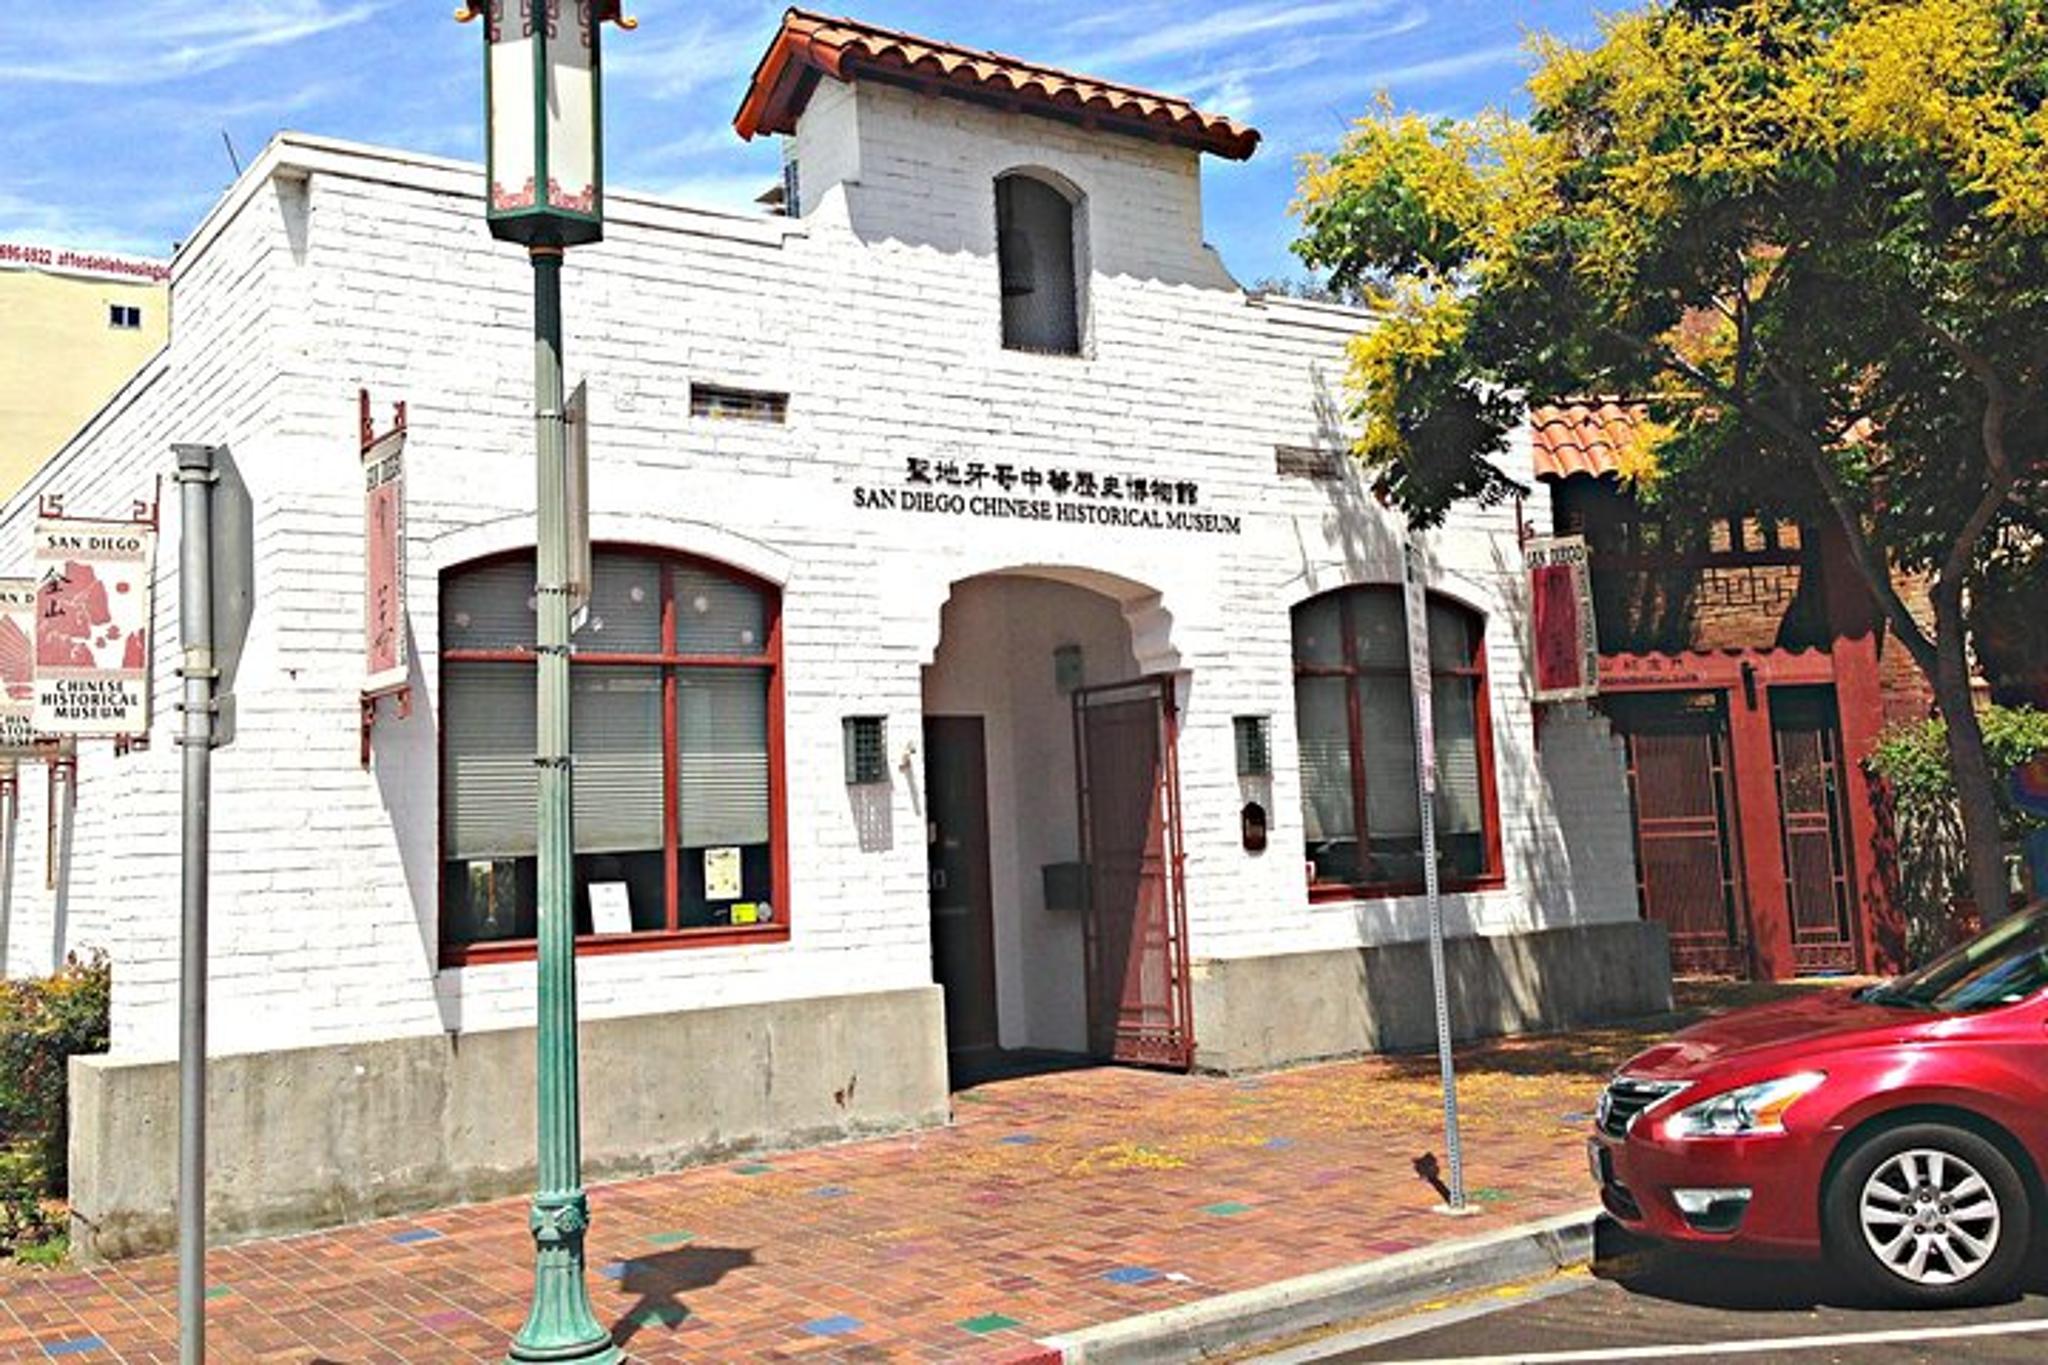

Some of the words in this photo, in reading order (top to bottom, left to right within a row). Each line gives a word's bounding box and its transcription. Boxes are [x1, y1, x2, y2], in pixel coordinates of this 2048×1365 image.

[853, 486, 896, 510] SAN
[900, 491, 966, 515] DIEGO
[969, 496, 1053, 522] CHINESE
[1056, 502, 1164, 529] HISTORICAL
[1166, 511, 1241, 534] MUSEUM
[47, 535, 81, 549] SAN
[89, 537, 140, 551] DIEGO
[56, 680, 123, 692] CHINESE
[41, 693, 138, 706] HISTORICAL
[54, 707, 126, 719] MUSEUM
